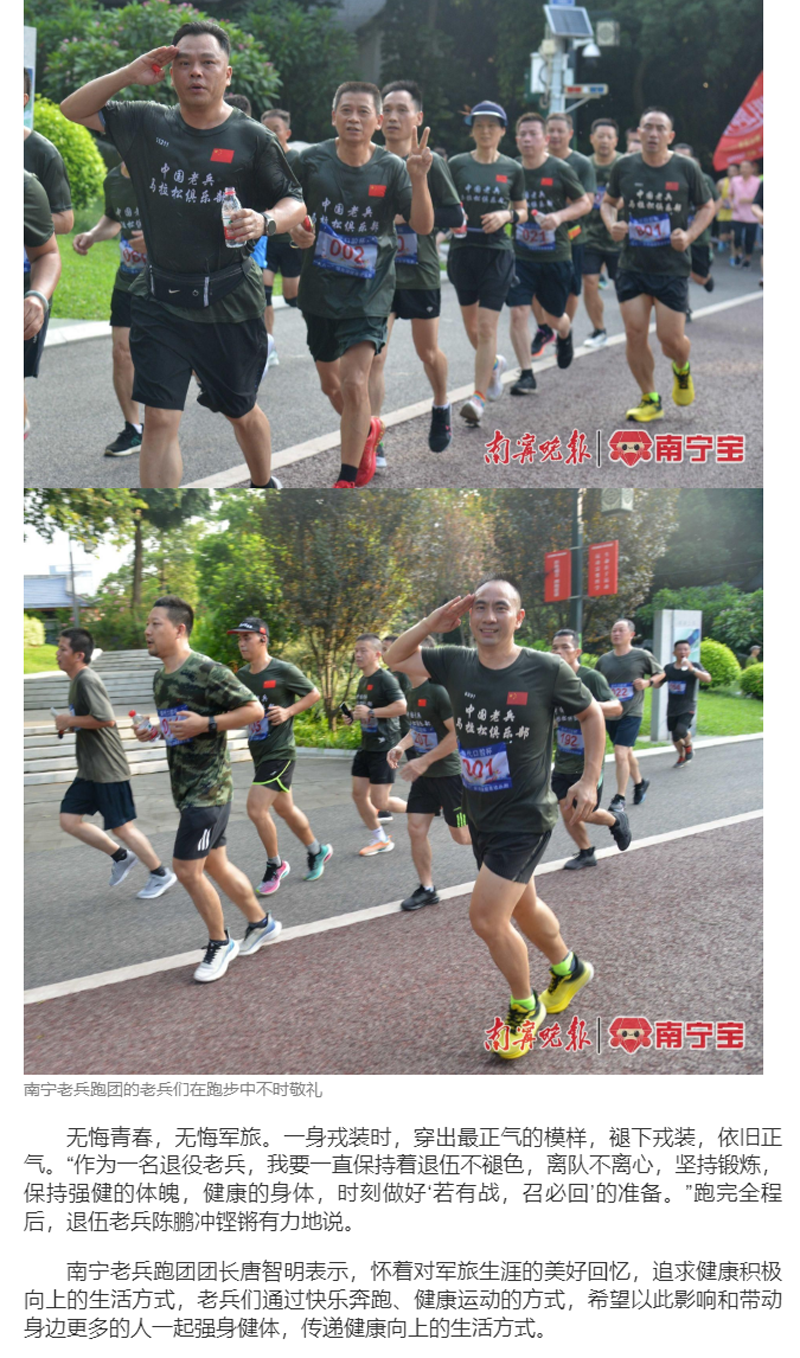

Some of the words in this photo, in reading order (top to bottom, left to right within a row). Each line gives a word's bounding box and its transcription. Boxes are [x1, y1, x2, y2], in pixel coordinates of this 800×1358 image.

[160, 162, 215, 187] 中国老兵
[321, 197, 374, 218] 中国老兵
[521, 228, 547, 243] 021
[330, 238, 365, 264] 002
[465, 704, 516, 723] 中国老兵
[456, 717, 531, 741] 马拉松俱乐部
[559, 733, 578, 746] 192
[24, 1082, 323, 1097] 南宁老兵跑团的老兵们在跑步中不时敬礼
[24, 1211, 352, 1233] 后，退伍老兵陈鹏冲铿锵有力地说。
[24, 1316, 544, 1339] 身边更多的人一起强身健体，传递健康向上的生活方式。
